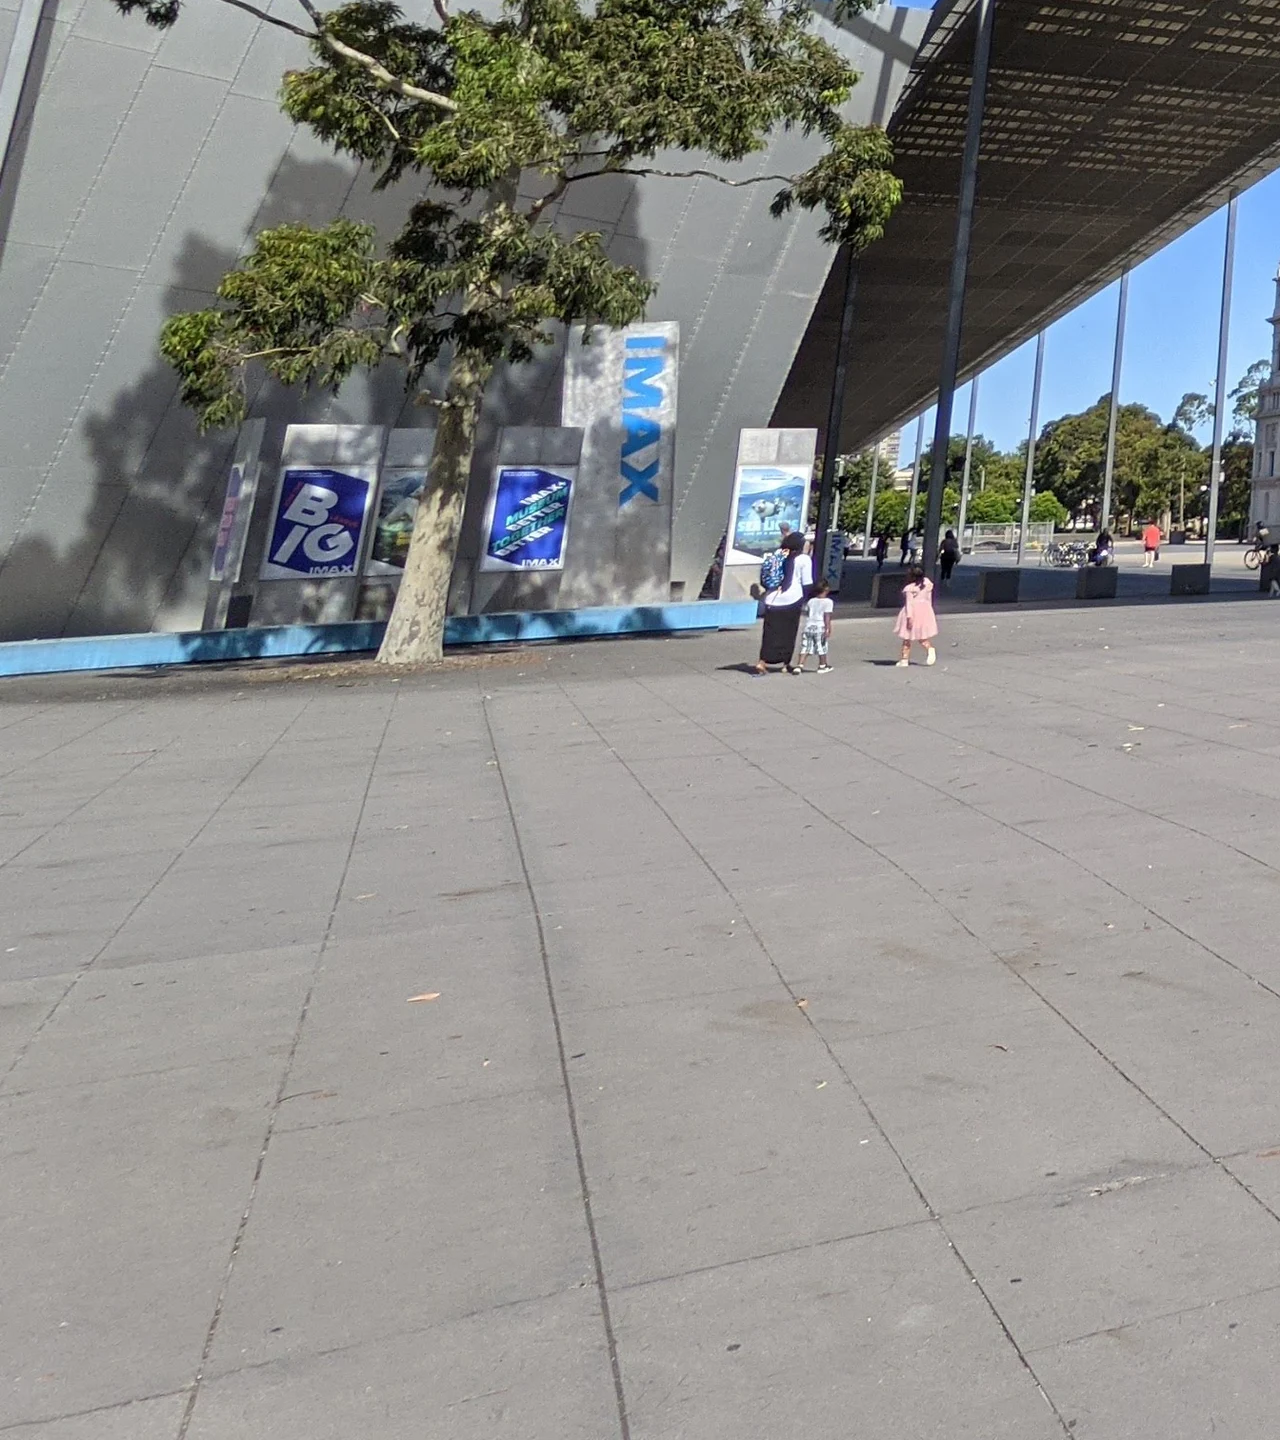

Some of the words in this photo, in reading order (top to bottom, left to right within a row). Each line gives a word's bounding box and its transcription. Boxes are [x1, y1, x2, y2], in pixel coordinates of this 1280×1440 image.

[619, 336, 668, 506] IMAX
[763, 520, 799, 533] LIS
[521, 558, 560, 567] IMAX
[827, 534, 842, 579] IMAX
[309, 564, 355, 575] IMAX
